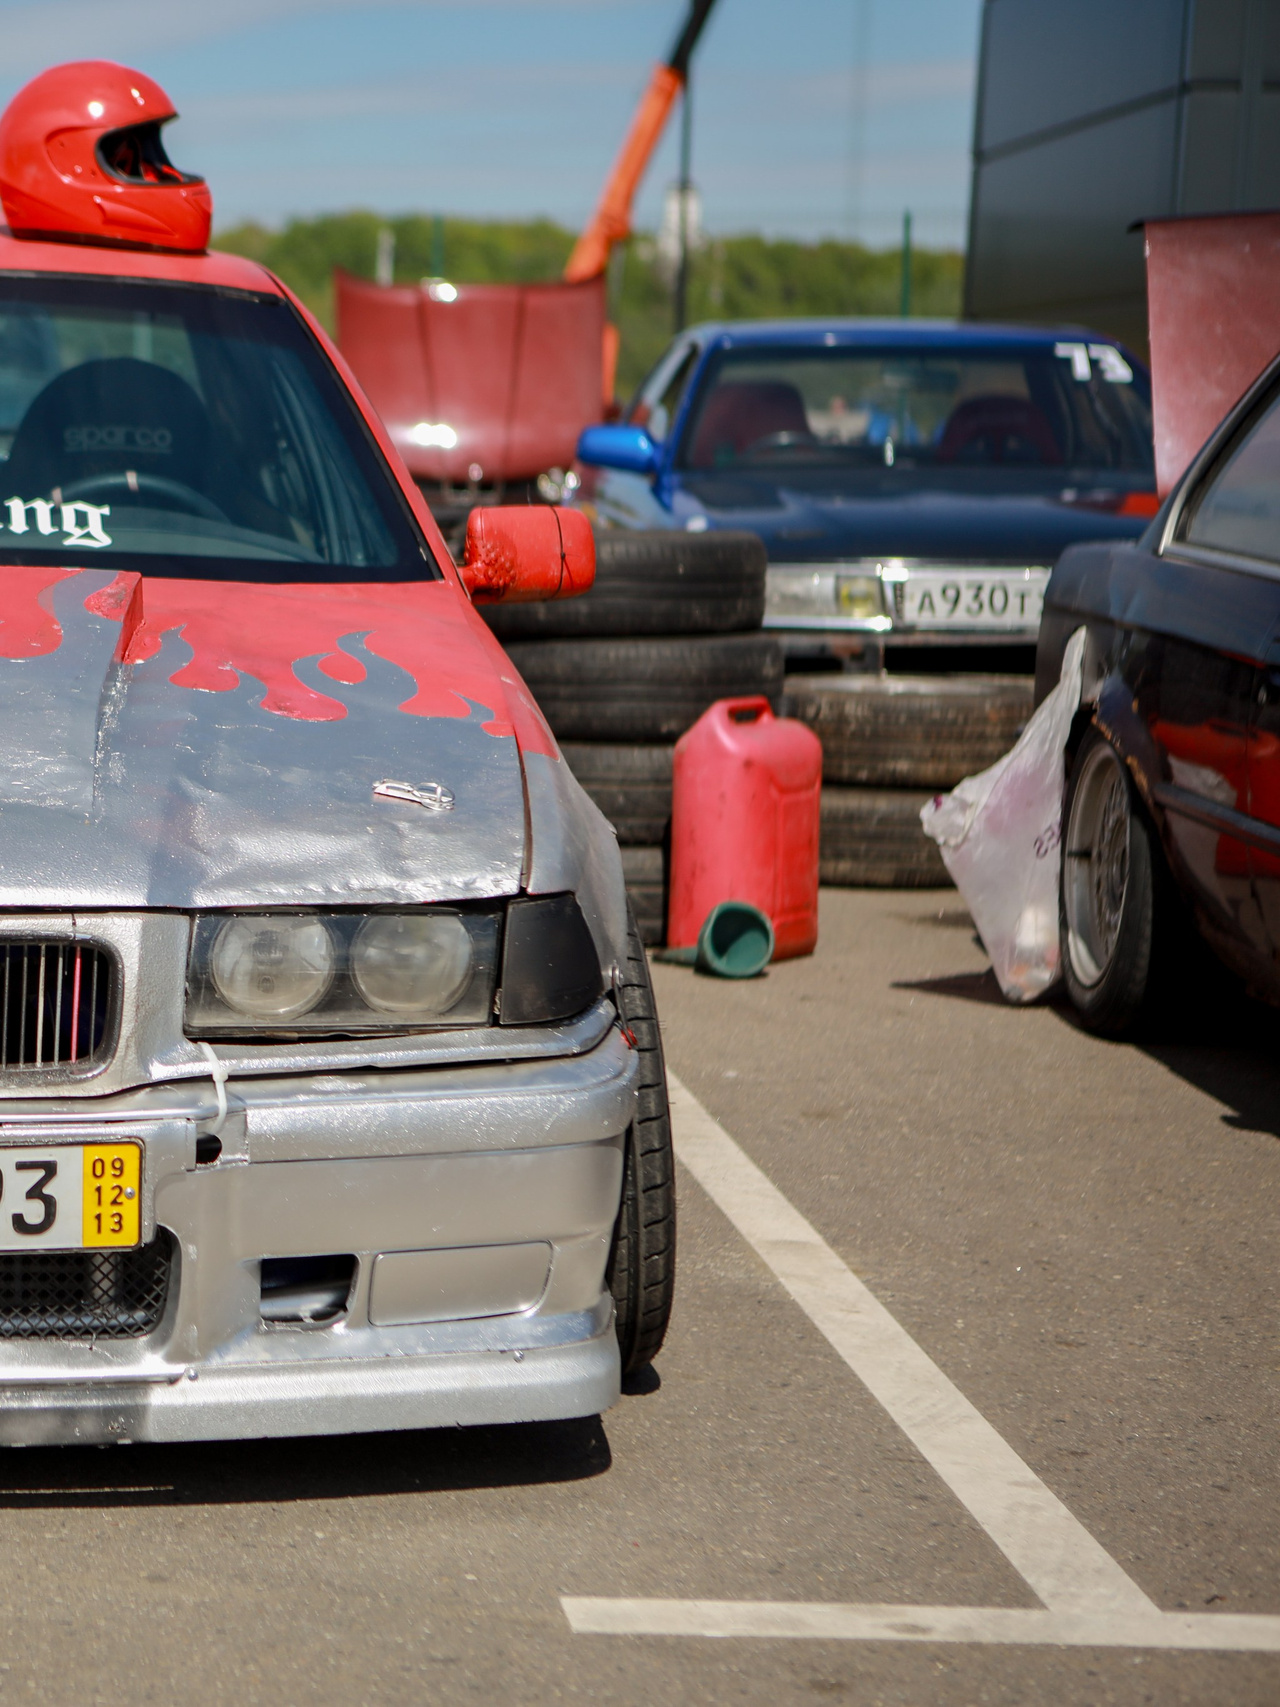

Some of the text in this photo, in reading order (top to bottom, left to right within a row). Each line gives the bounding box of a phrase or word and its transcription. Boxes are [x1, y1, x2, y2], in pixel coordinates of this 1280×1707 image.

[1054, 342, 1133, 383] 73
[918, 580, 1044, 617] А930Т
[92, 1157, 125, 1179] 09
[94, 1184, 125, 1206] 12
[94, 1212, 124, 1234] 13
